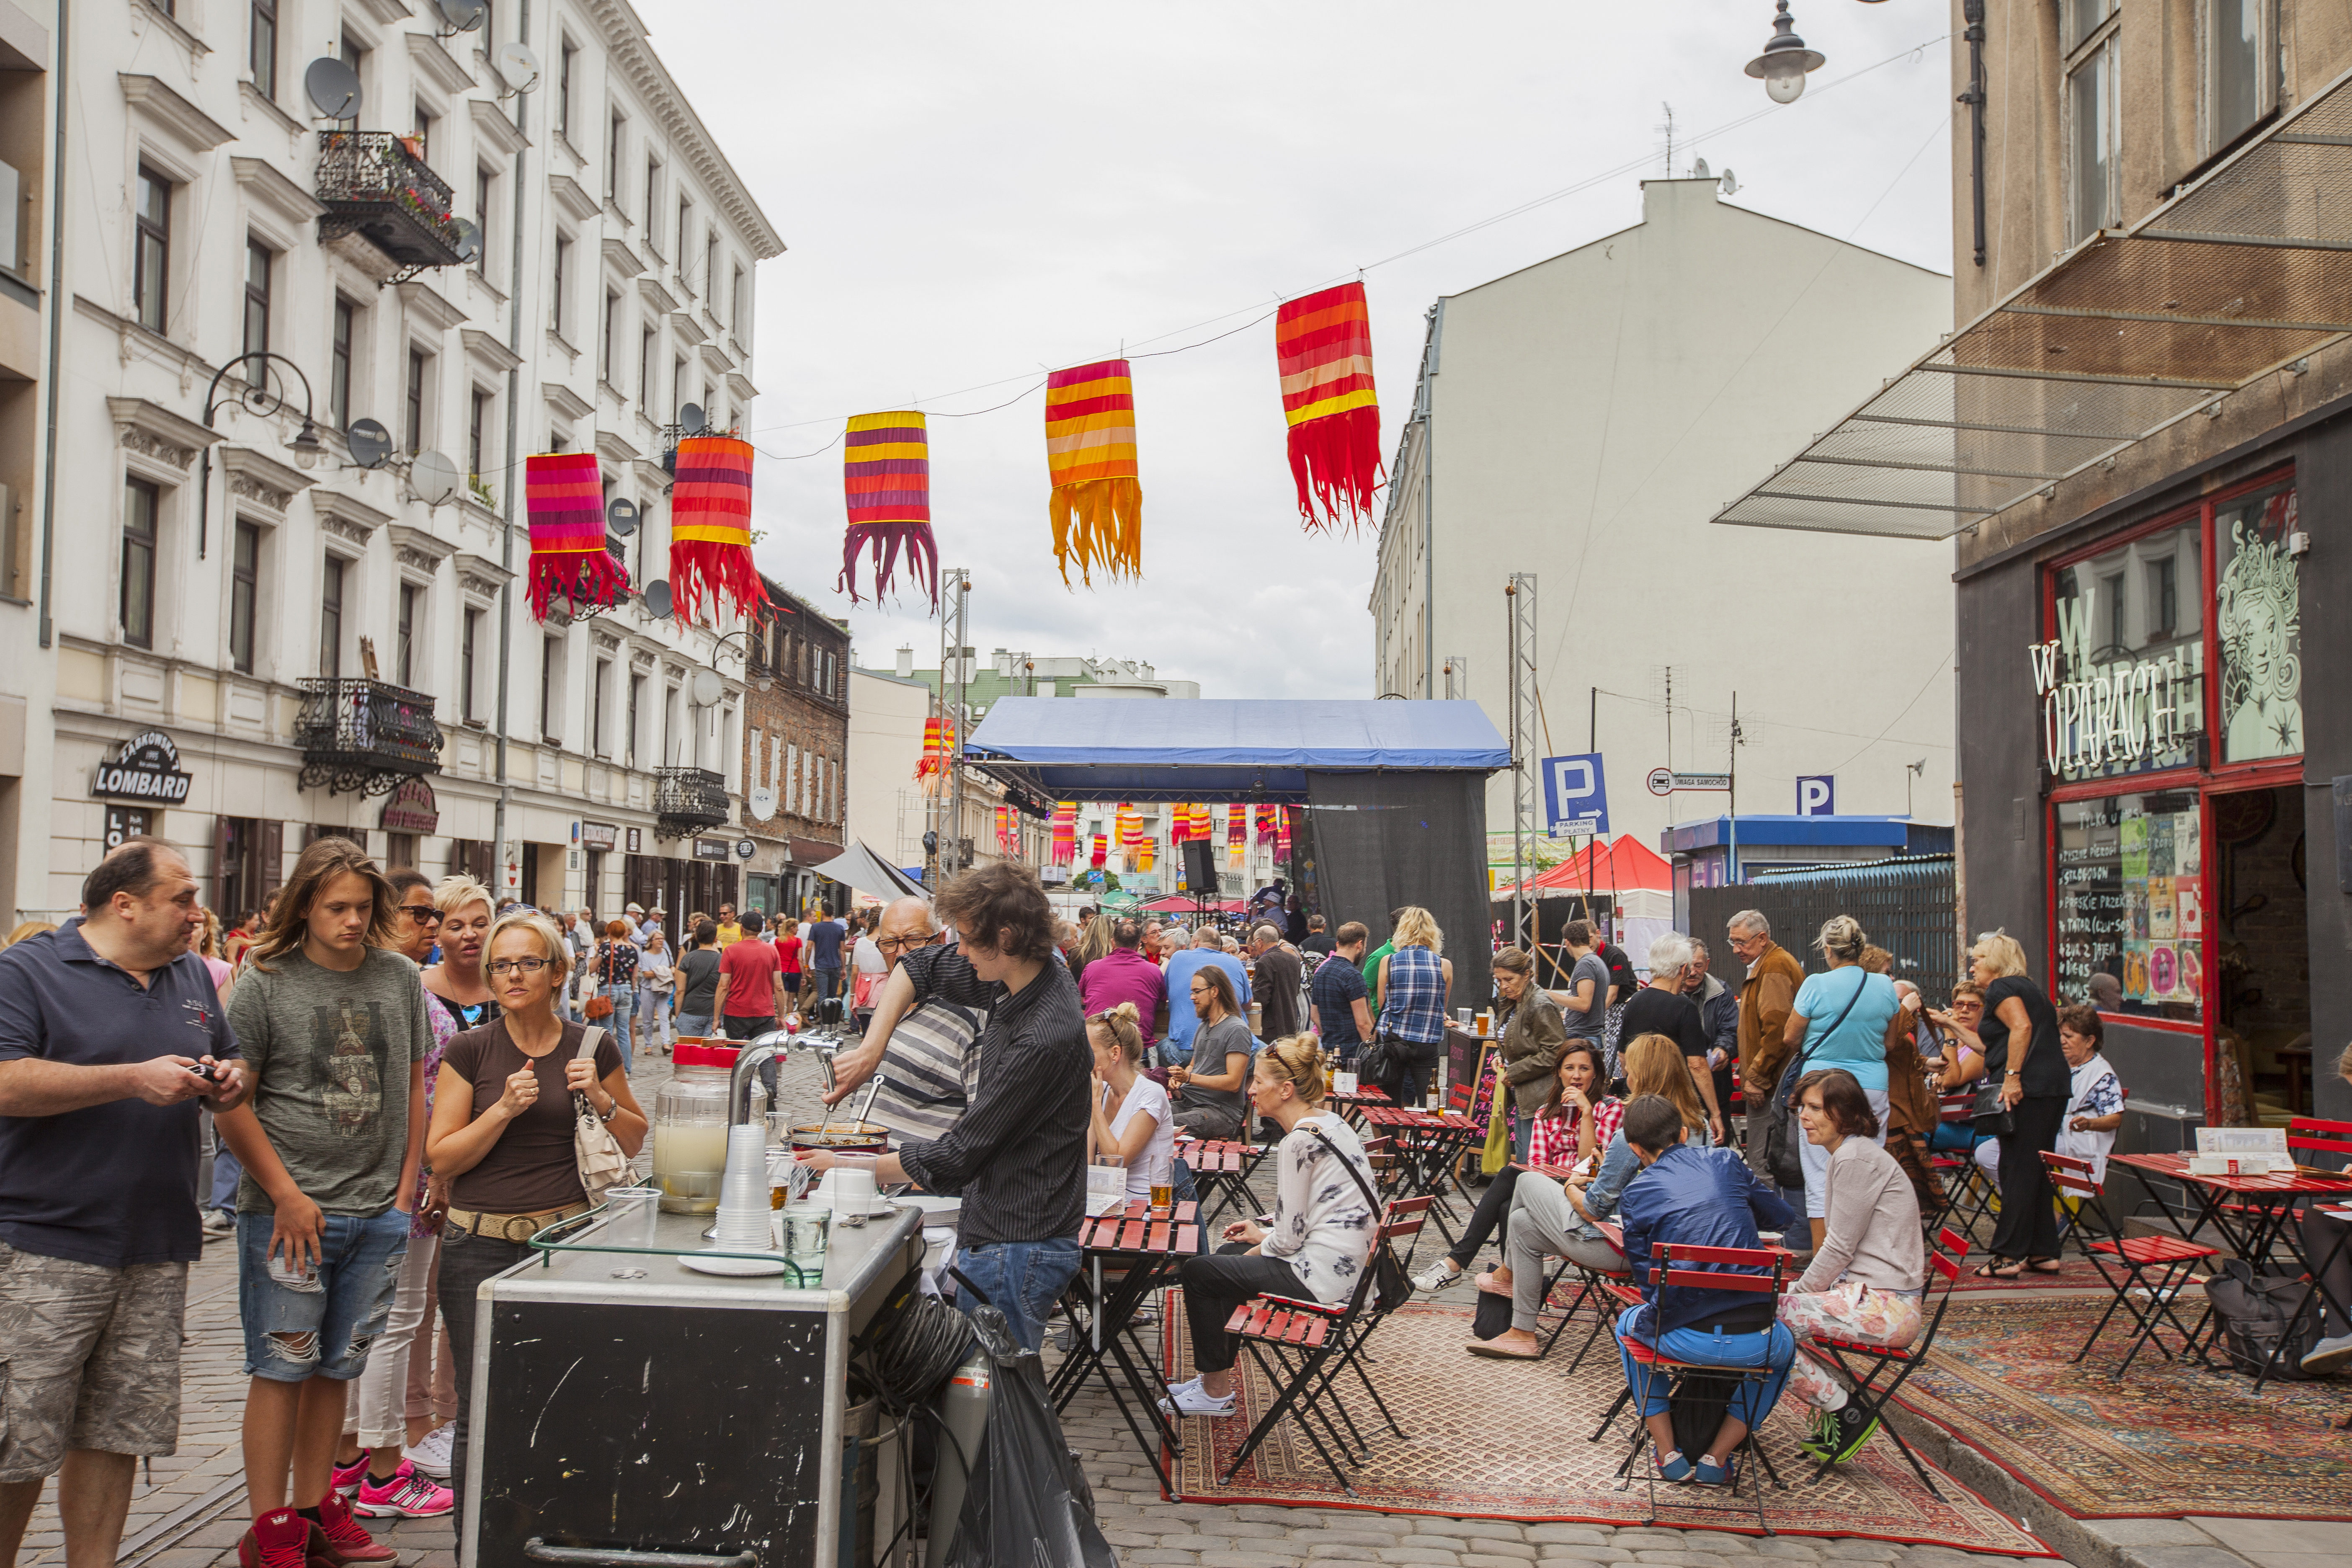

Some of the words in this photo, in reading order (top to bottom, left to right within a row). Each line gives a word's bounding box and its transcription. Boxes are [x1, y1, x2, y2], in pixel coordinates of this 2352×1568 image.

[2028, 639, 2061, 696] W
[2045, 663, 2179, 776] OPARACH
[95, 767, 188, 799] LOMBARD
[1554, 760, 1595, 820] P
[1802, 780, 1830, 815] P
